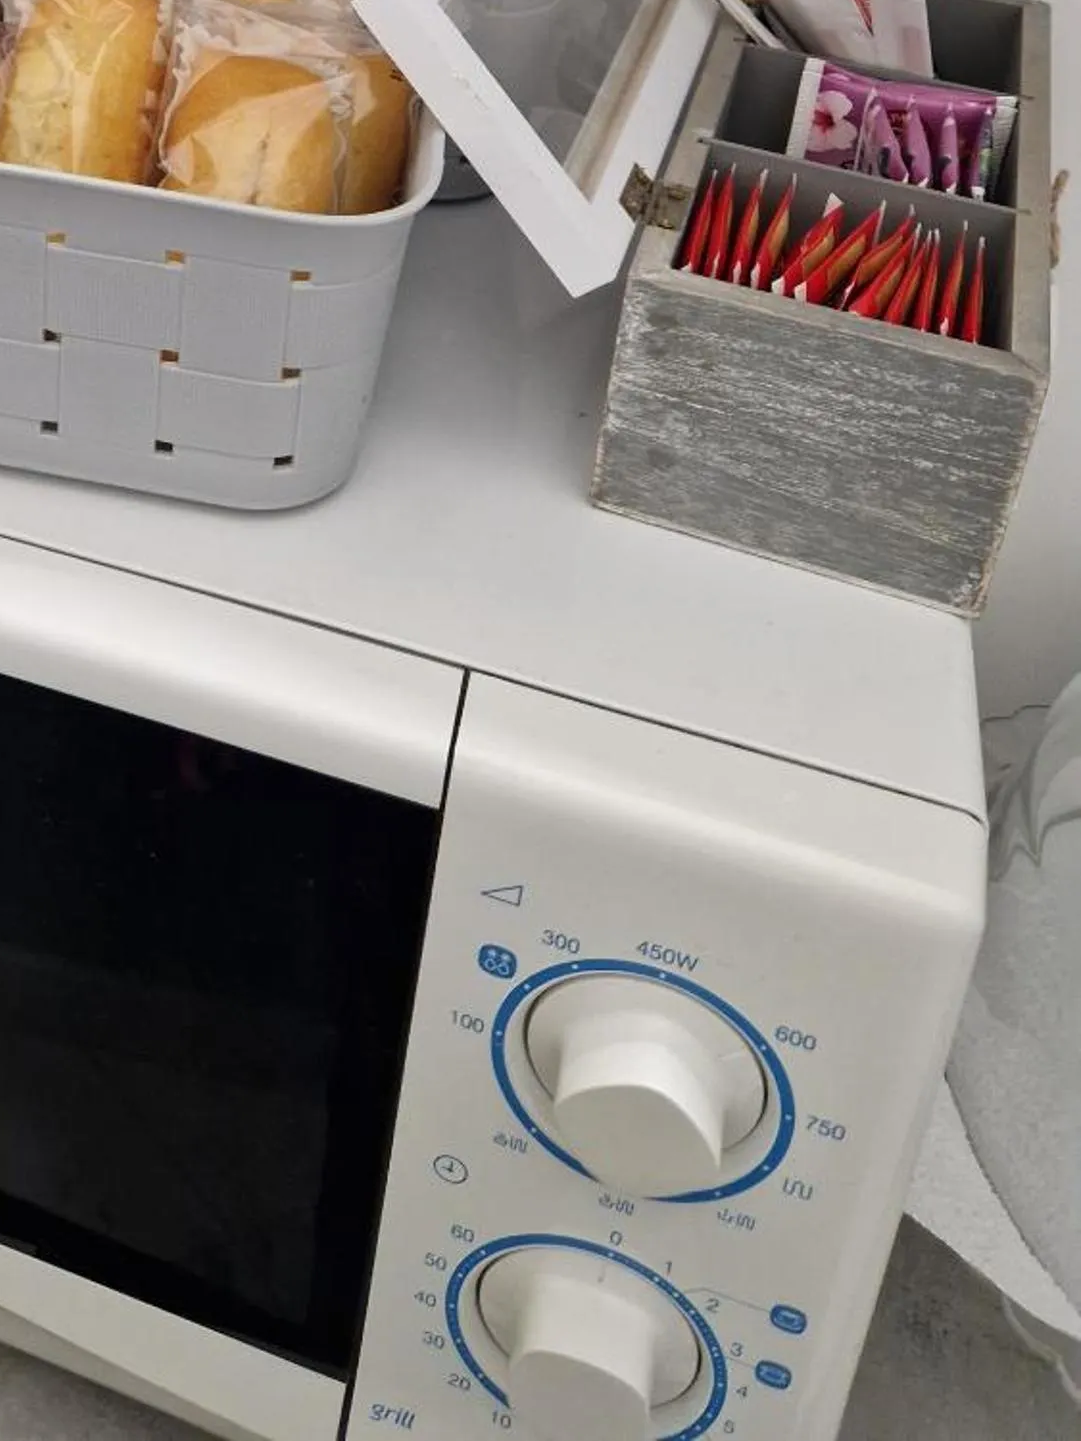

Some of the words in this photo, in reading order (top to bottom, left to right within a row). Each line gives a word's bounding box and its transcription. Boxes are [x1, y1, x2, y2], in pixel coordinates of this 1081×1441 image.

[541, 929, 581, 954] 300
[635, 940, 700, 972] 450W
[451, 1010, 485, 1034] 100
[775, 1025, 817, 1051] 600
[806, 1114, 847, 1141] 750
[450, 1223, 475, 1244] 60
[609, 1230, 624, 1247] 0
[424, 1252, 448, 1272] 50
[414, 1291, 437, 1308] 40
[705, 1298, 720, 1314] 2
[422, 1331, 445, 1350] 30
[730, 1342, 744, 1358] 3
[447, 1372, 472, 1392] 20
[736, 1385, 749, 1399] 4
[369, 1403, 417, 1430] grill
[491, 1410, 512, 1430] 10
[723, 1419, 736, 1435] 5
